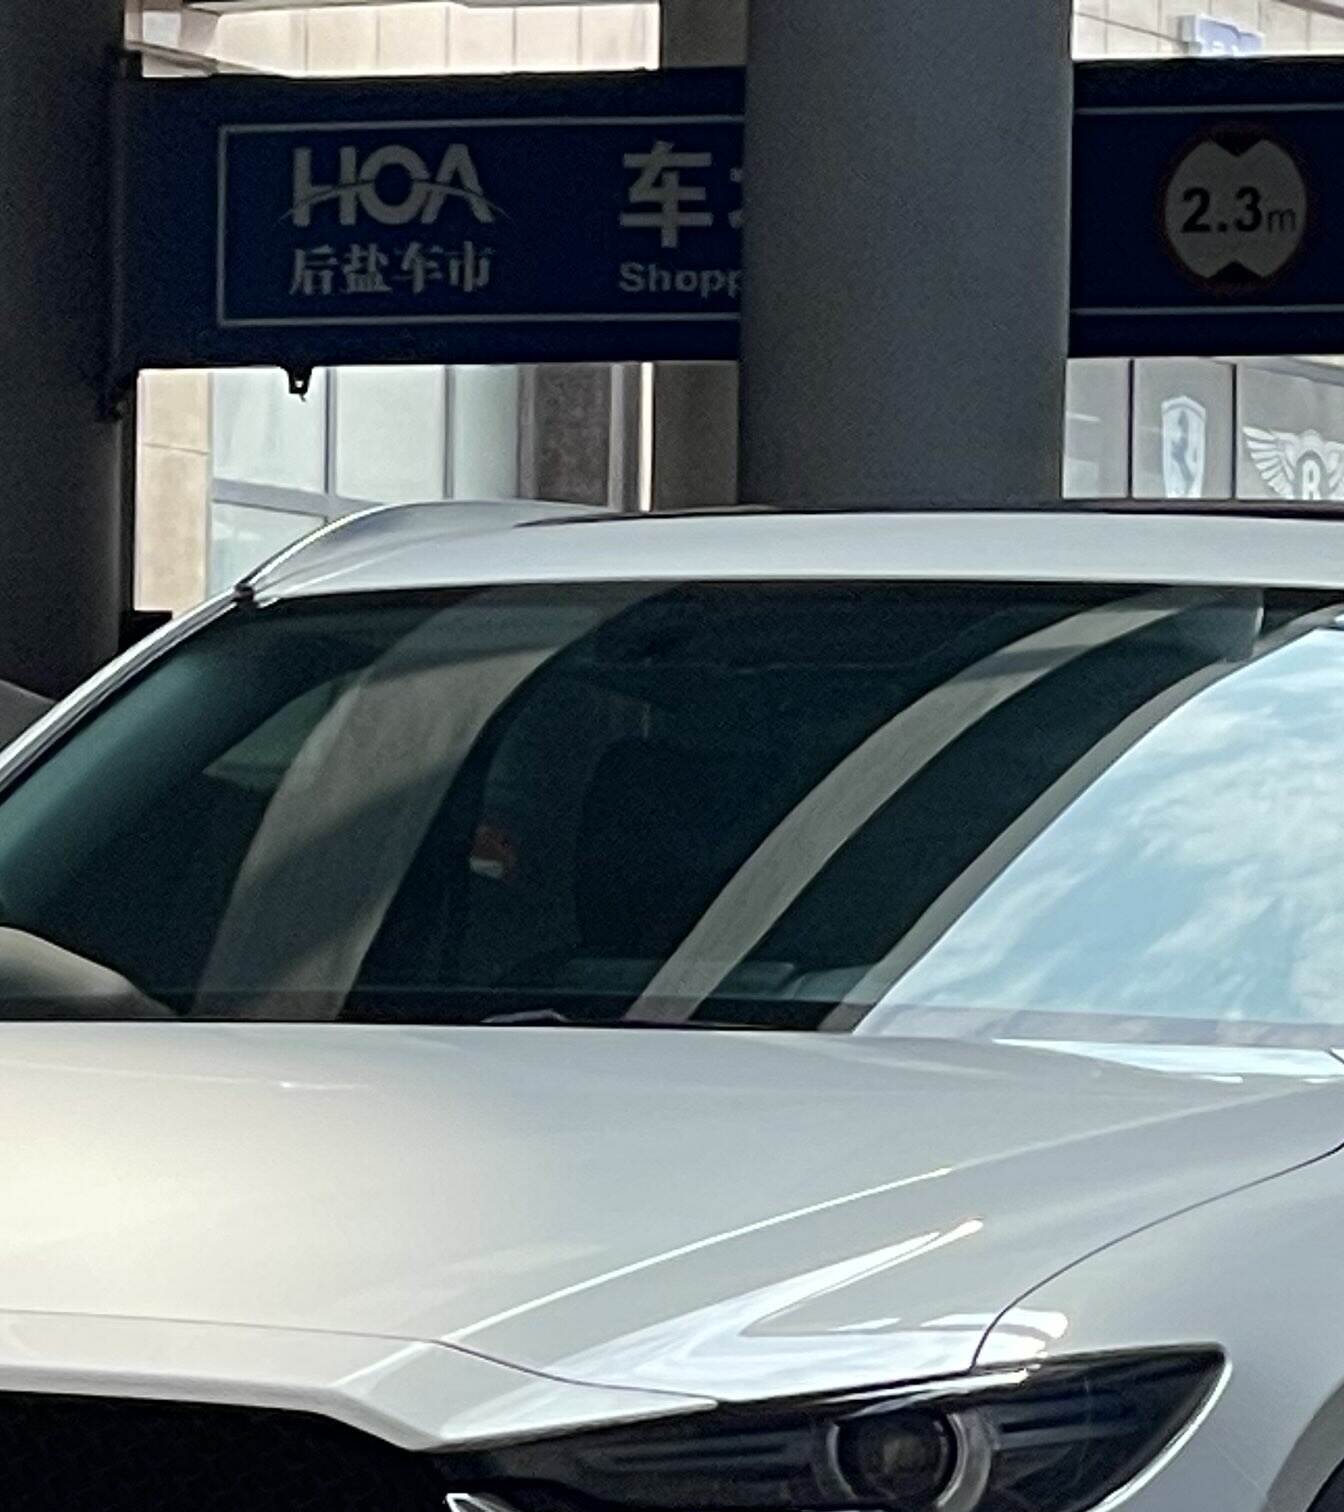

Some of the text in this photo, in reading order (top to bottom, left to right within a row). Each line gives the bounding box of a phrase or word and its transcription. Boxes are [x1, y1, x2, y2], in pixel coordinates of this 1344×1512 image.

[292, 143, 494, 228] HOA
[619, 140, 744, 248] 车
[1181, 186, 1297, 233] 2.3m
[288, 241, 496, 296] 后盐车市
